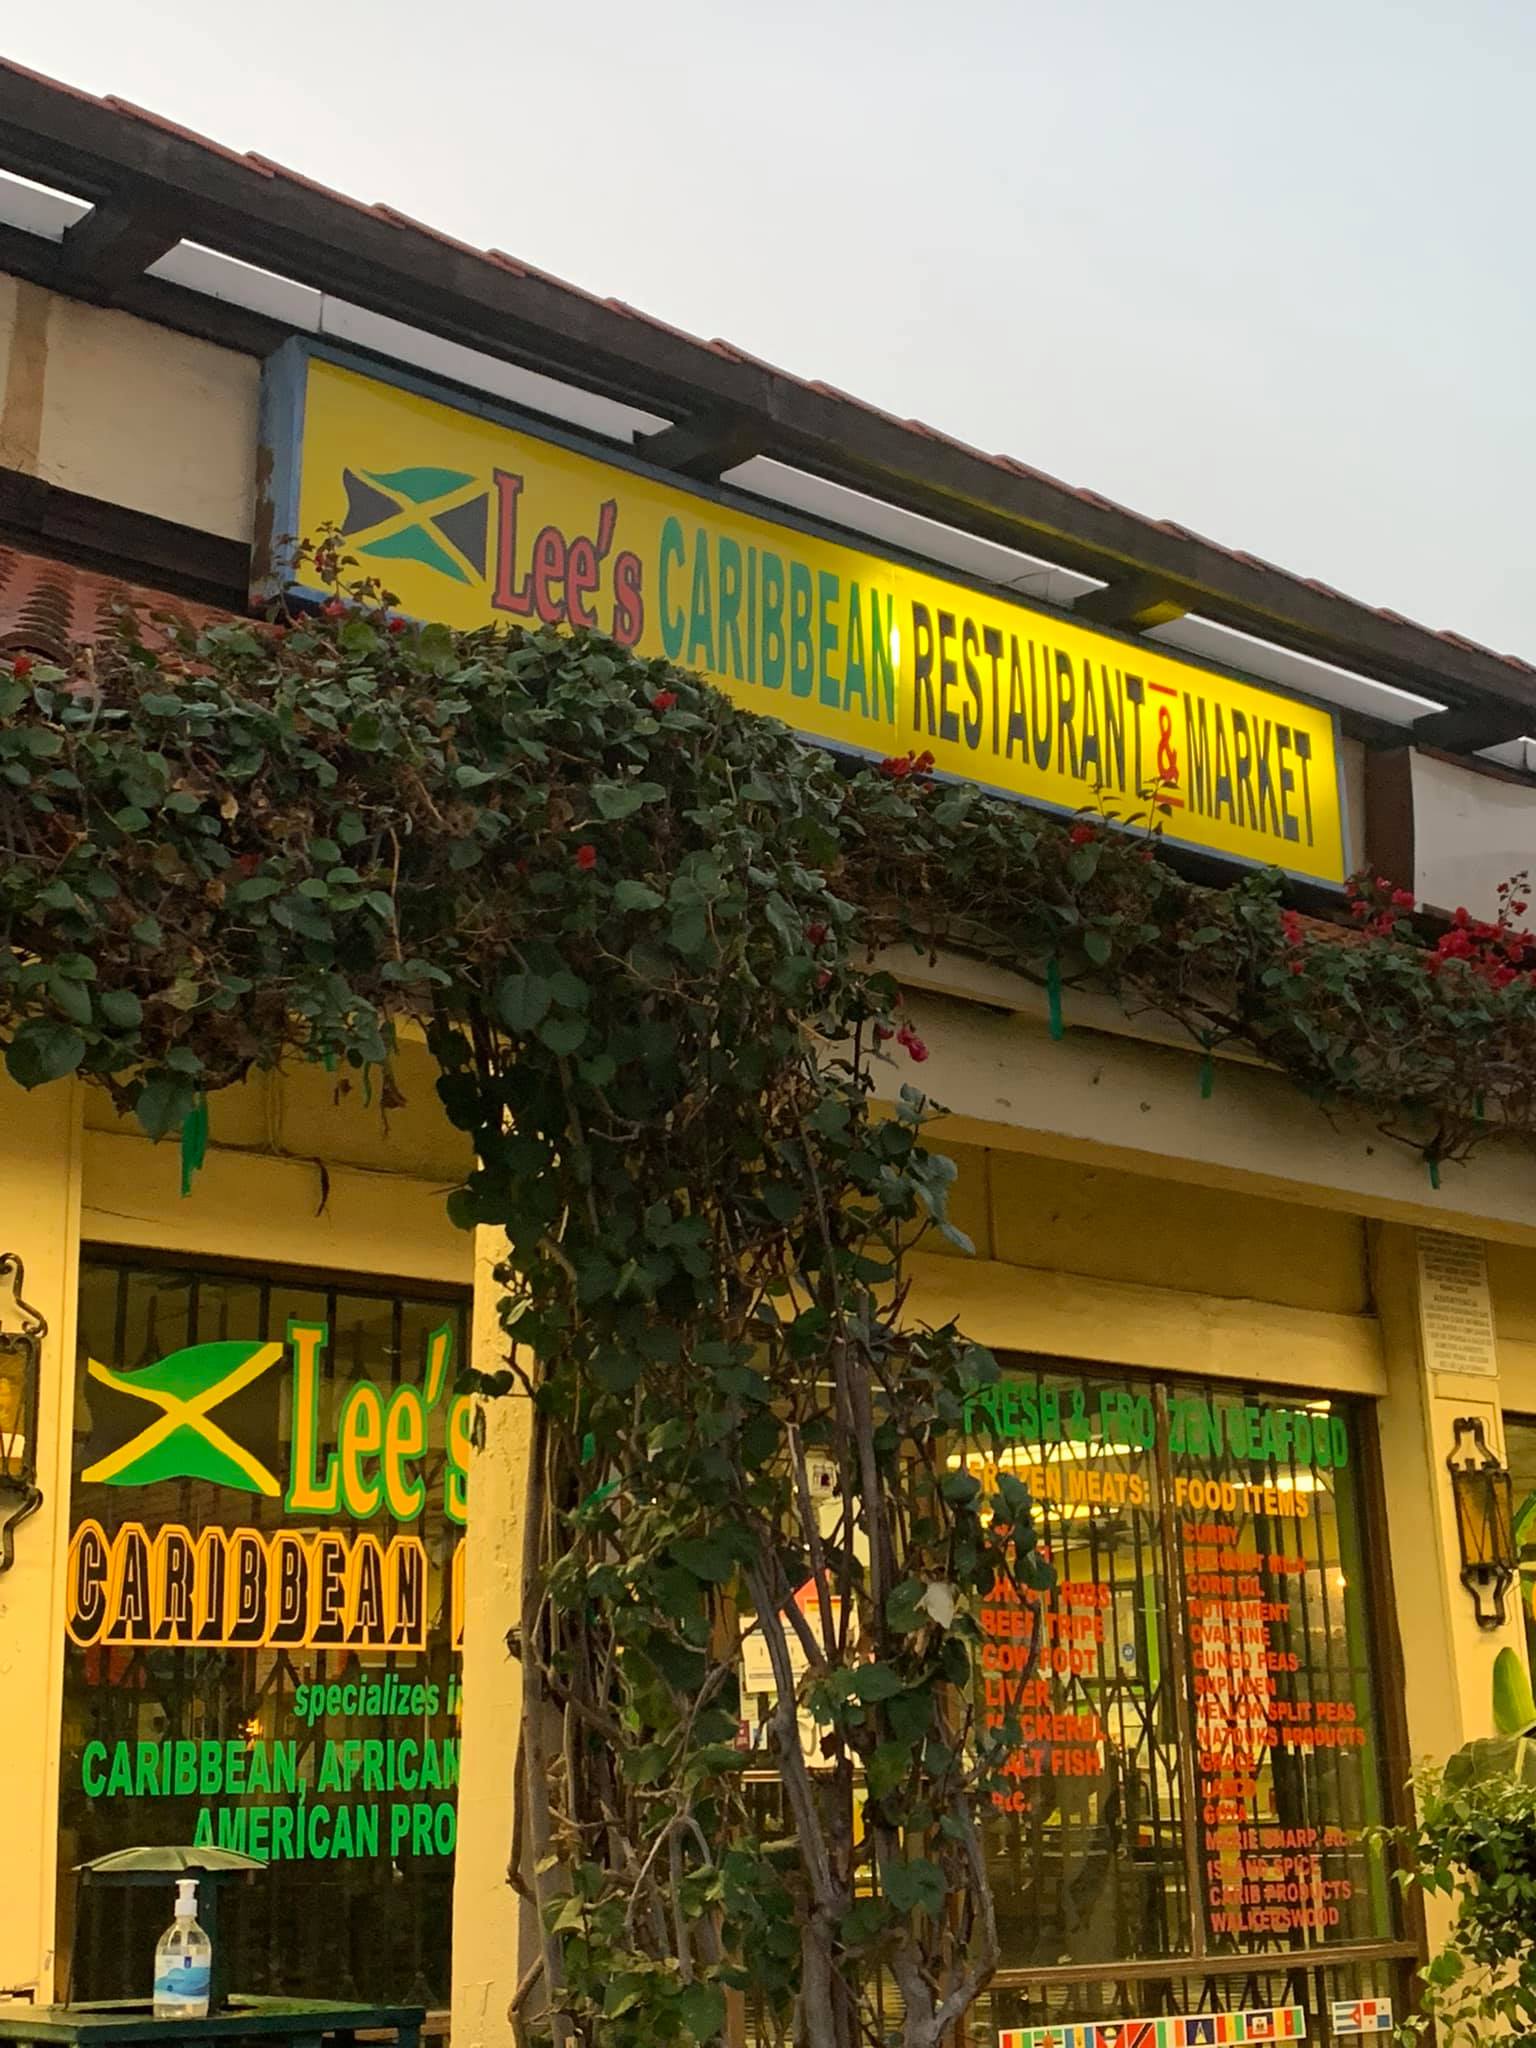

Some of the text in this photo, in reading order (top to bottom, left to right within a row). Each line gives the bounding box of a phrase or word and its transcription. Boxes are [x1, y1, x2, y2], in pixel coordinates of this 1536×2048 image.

[491, 467, 1313, 847] Lee's CARIBBEAN RESTAURANT & MARKET
[967, 1460, 1150, 1505] FRZEN MEATS:
[1175, 1477, 1309, 1518] FOOD ITEMS
[65, 1519, 427, 1651] CARIBBEAN
[1046, 1612, 1105, 1643] TRIPE
[1191, 1624, 1271, 1646] OVALTINE
[1039, 1647, 1096, 1674] FOOT
[1257, 1651, 1298, 1672] PEAS
[293, 1674, 440, 1727] specializes
[985, 1678, 1050, 1706] LIVER
[986, 1711, 1107, 1742] MCKEREL
[1267, 1702, 1311, 1721] SPLIT
[1316, 1702, 1356, 1722] PEAS
[1282, 1727, 1366, 1748] PRODUCTS
[82, 1738, 461, 1798] CARIBBEAN, AFRICAN
[1051, 1747, 1102, 1776] FISH
[194, 1804, 378, 1859] AMERICAN
[1263, 1880, 1352, 1903] PRODUCTS
